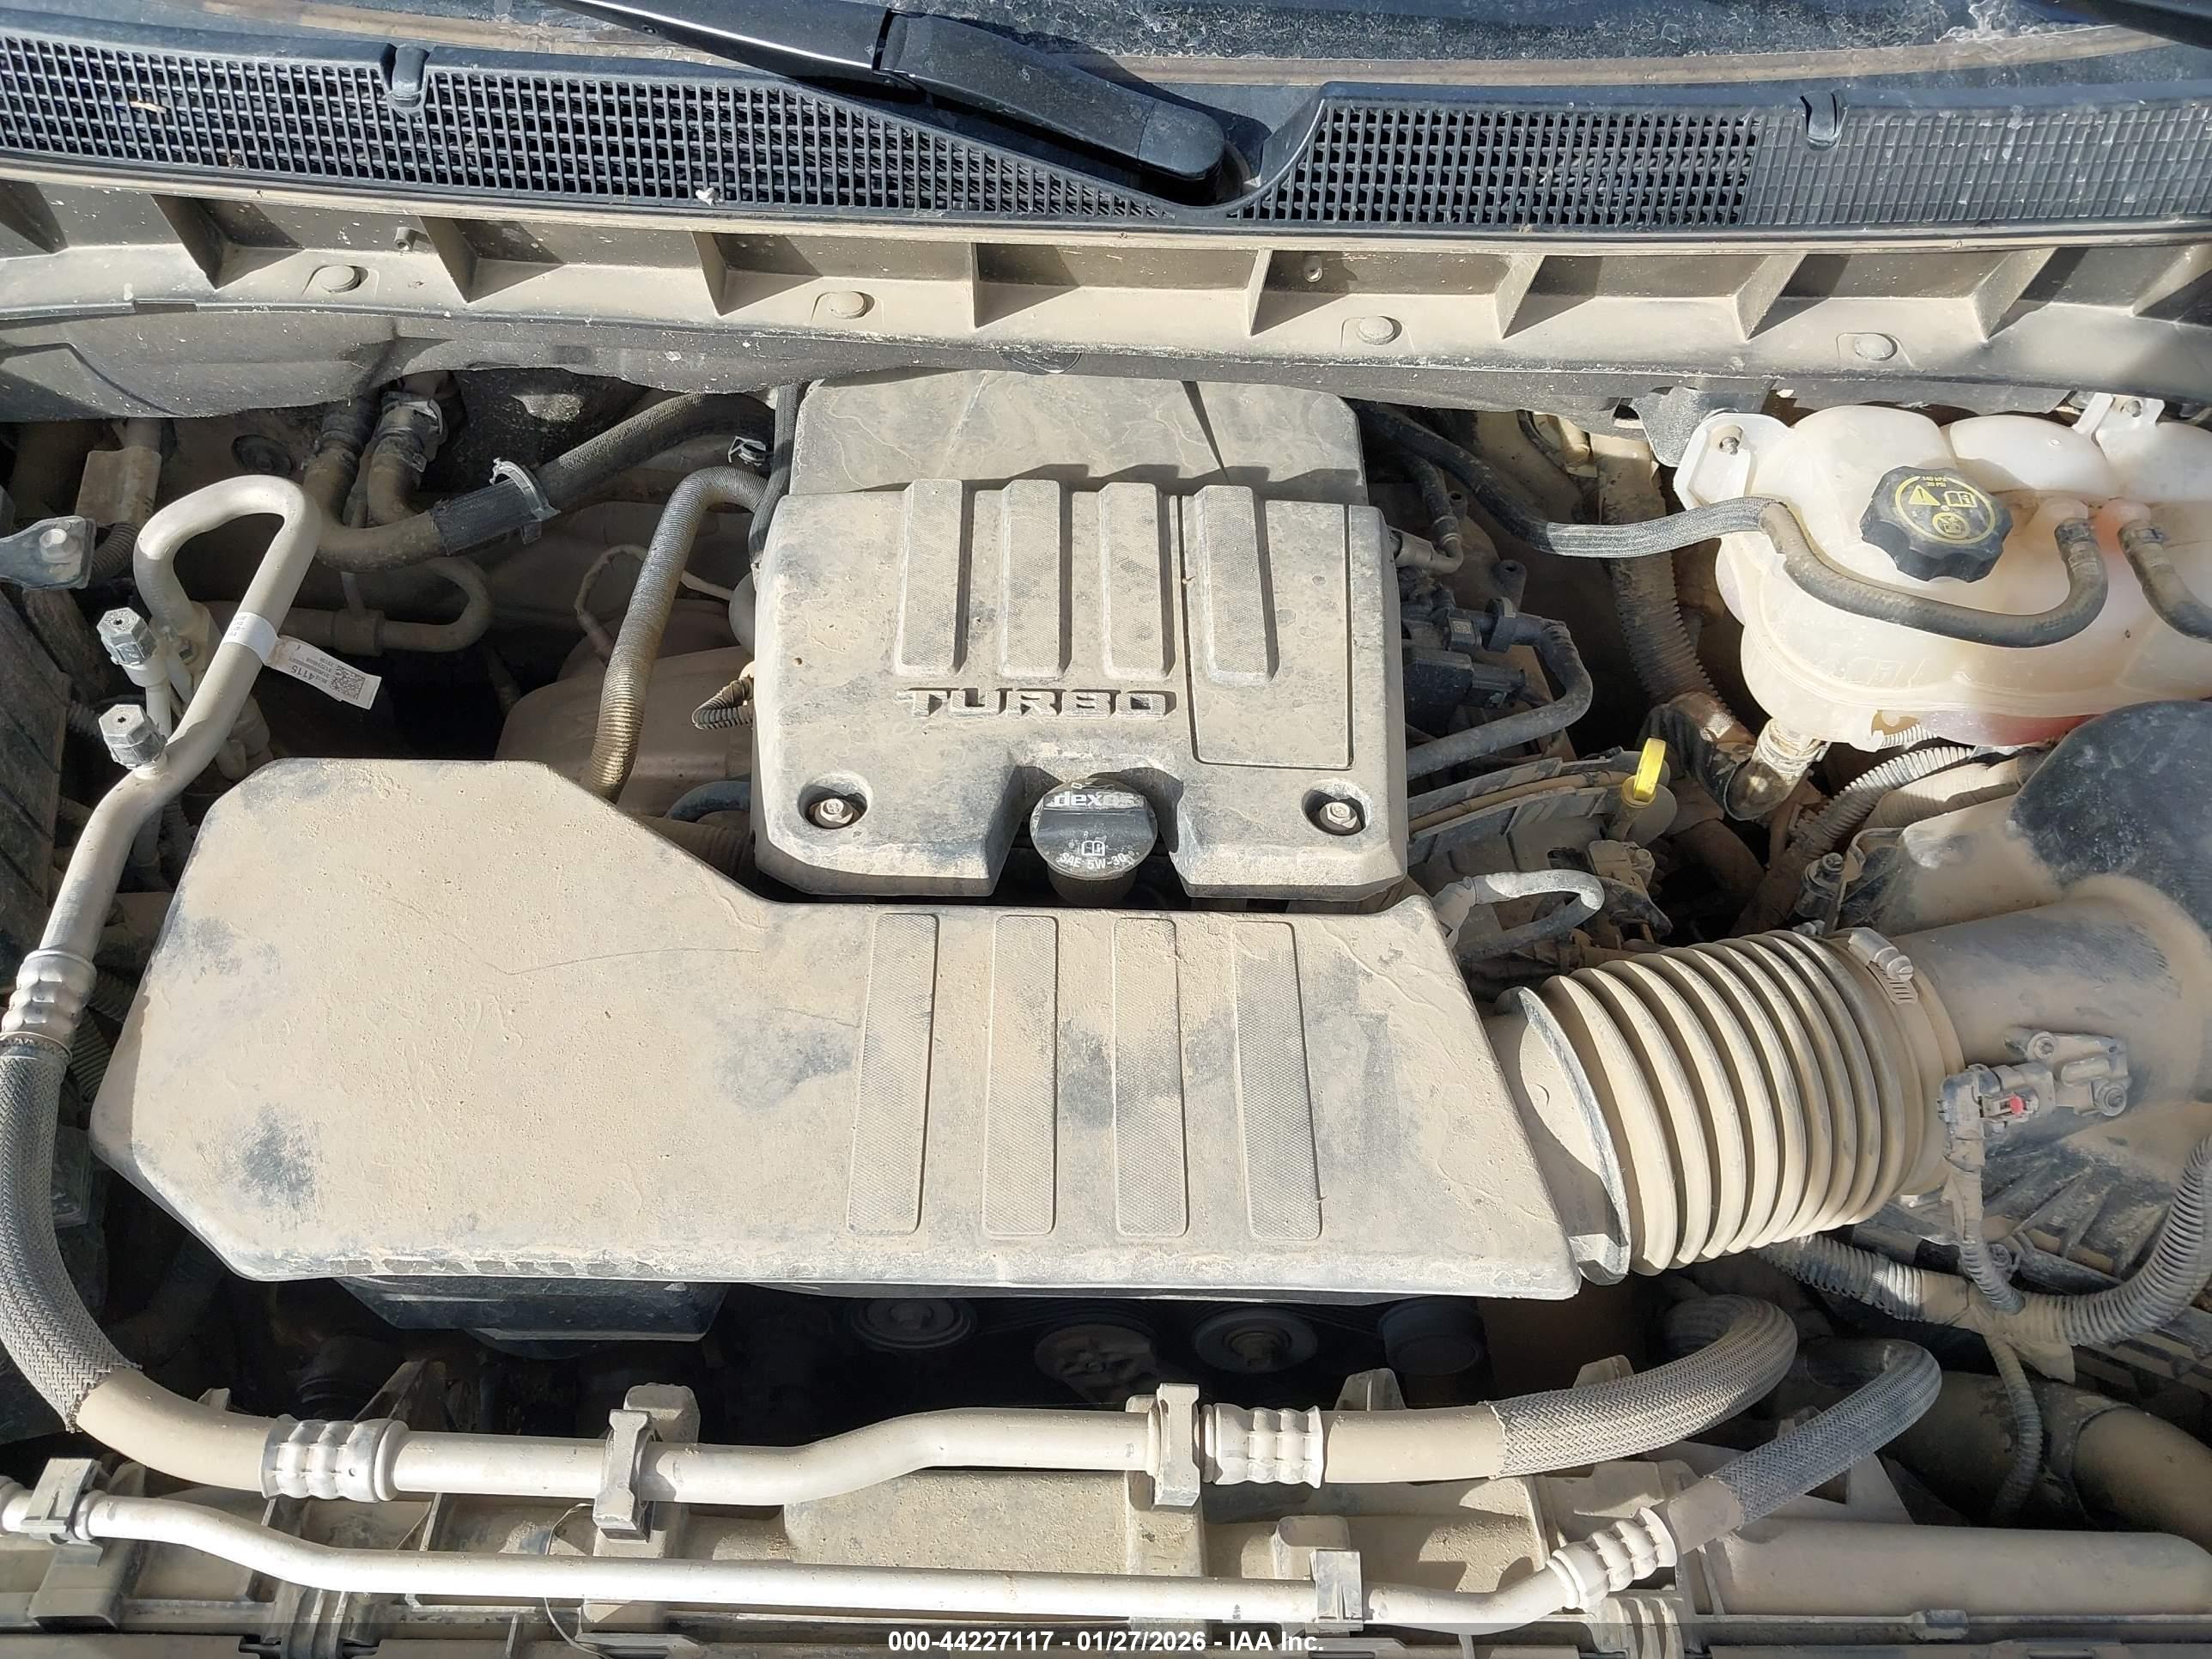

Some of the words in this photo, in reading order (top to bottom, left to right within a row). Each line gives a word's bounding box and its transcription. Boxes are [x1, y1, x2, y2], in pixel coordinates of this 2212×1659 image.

[896, 688, 1170, 718] TURBO
[1054, 790, 1135, 807] dexos
[1060, 852, 1082, 868] SAE
[1086, 853, 1125, 870] 5W-30
